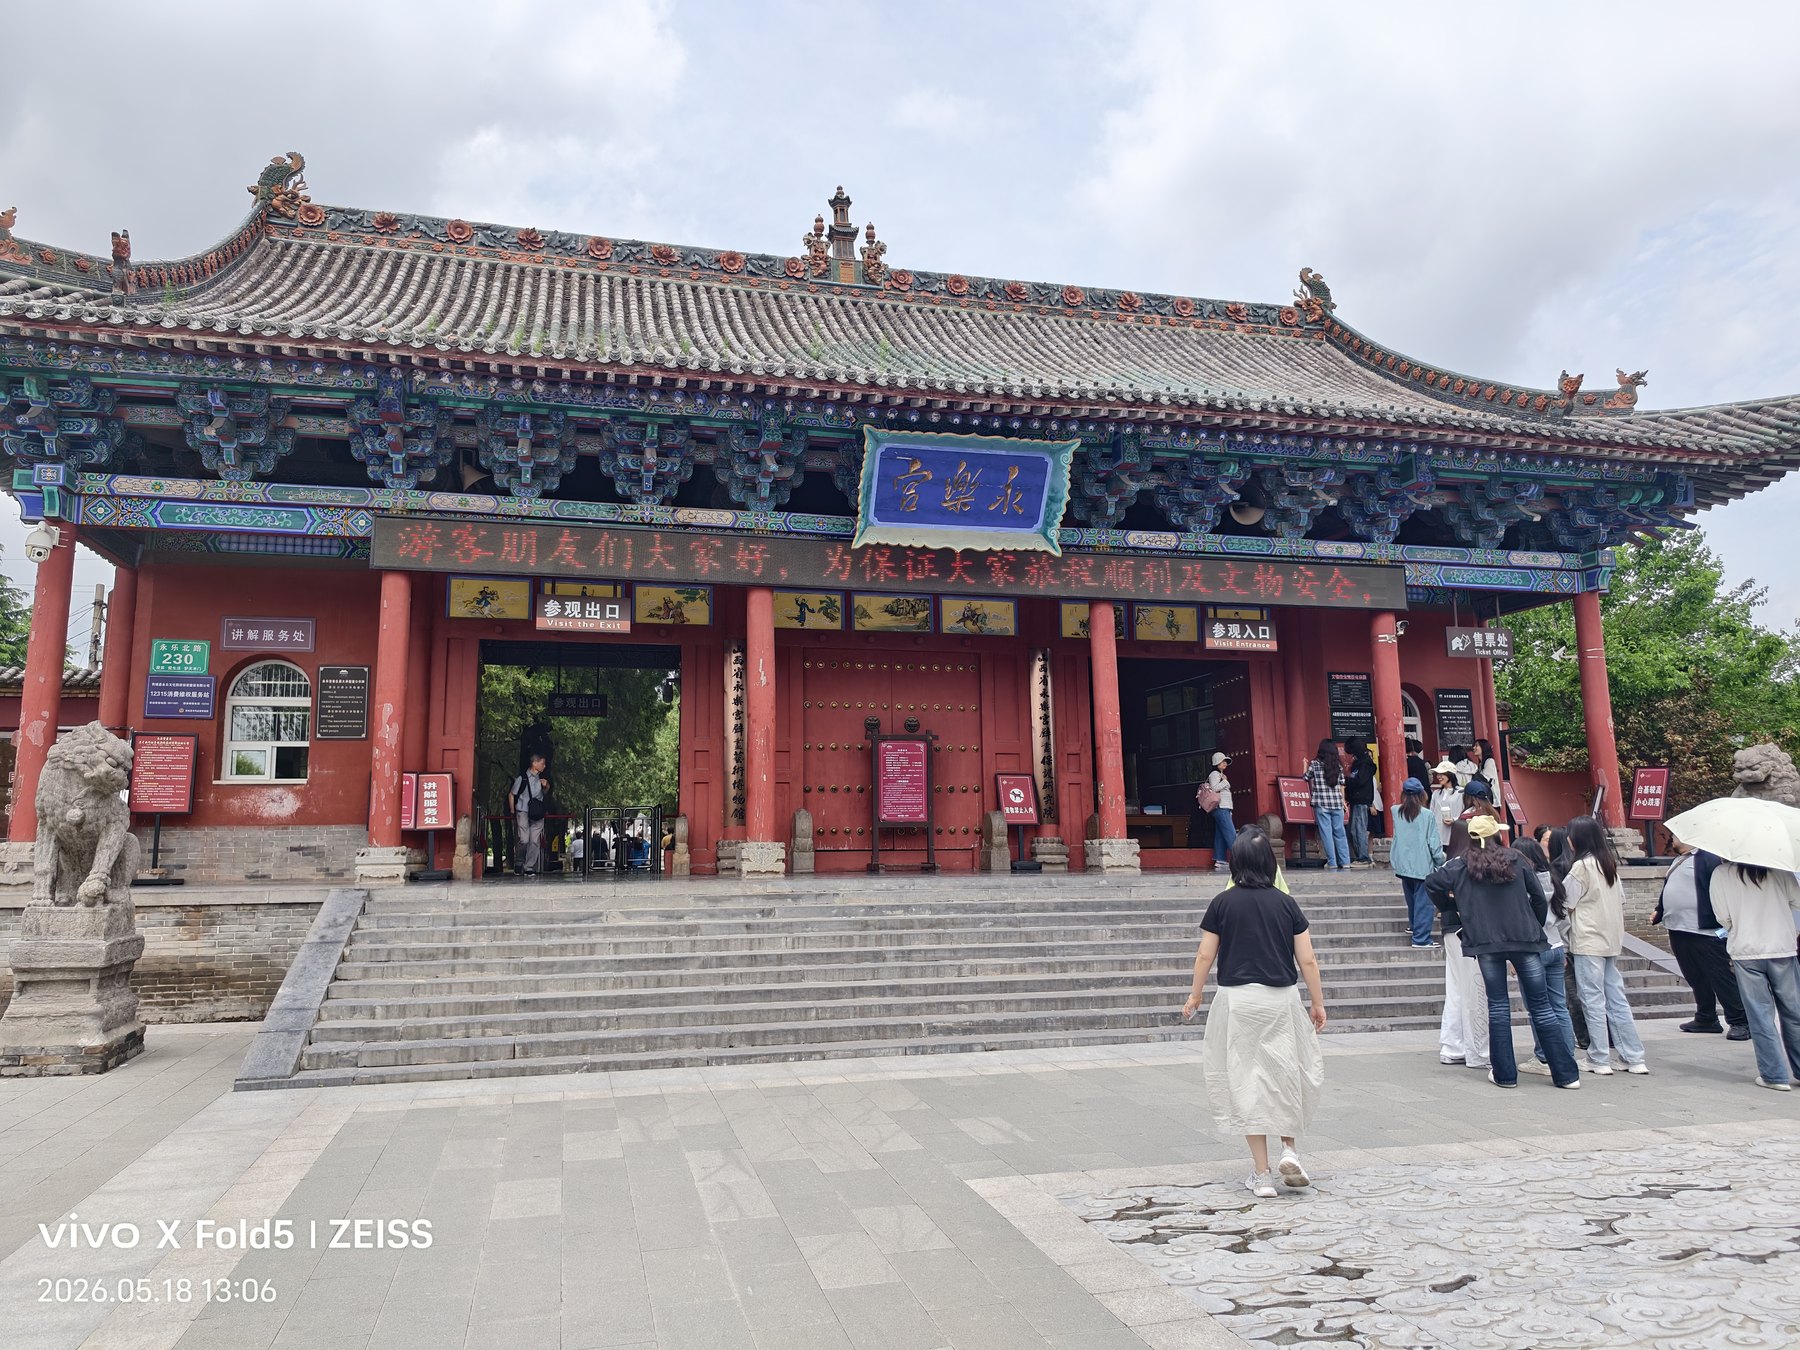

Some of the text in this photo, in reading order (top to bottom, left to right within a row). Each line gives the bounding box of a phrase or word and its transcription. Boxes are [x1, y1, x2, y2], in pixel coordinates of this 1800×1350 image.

[544, 599, 619, 619] 参观出口
[547, 619, 573, 627] Visit
[600, 621, 621, 629] Exit
[231, 628, 305, 642] 讲解服务处
[1212, 622, 1270, 639] 参观入口
[1236, 640, 1270, 648] Entrance
[1472, 631, 1508, 648] 售票处
[159, 643, 202, 652] 永乐北路
[162, 653, 194, 665] 230
[150, 690, 210, 698] 12315消费维权服务站
[1637, 785, 1662, 794] 台基较高
[423, 781, 439, 825] 讲解服务处
[1635, 797, 1661, 807] 小心跌落
